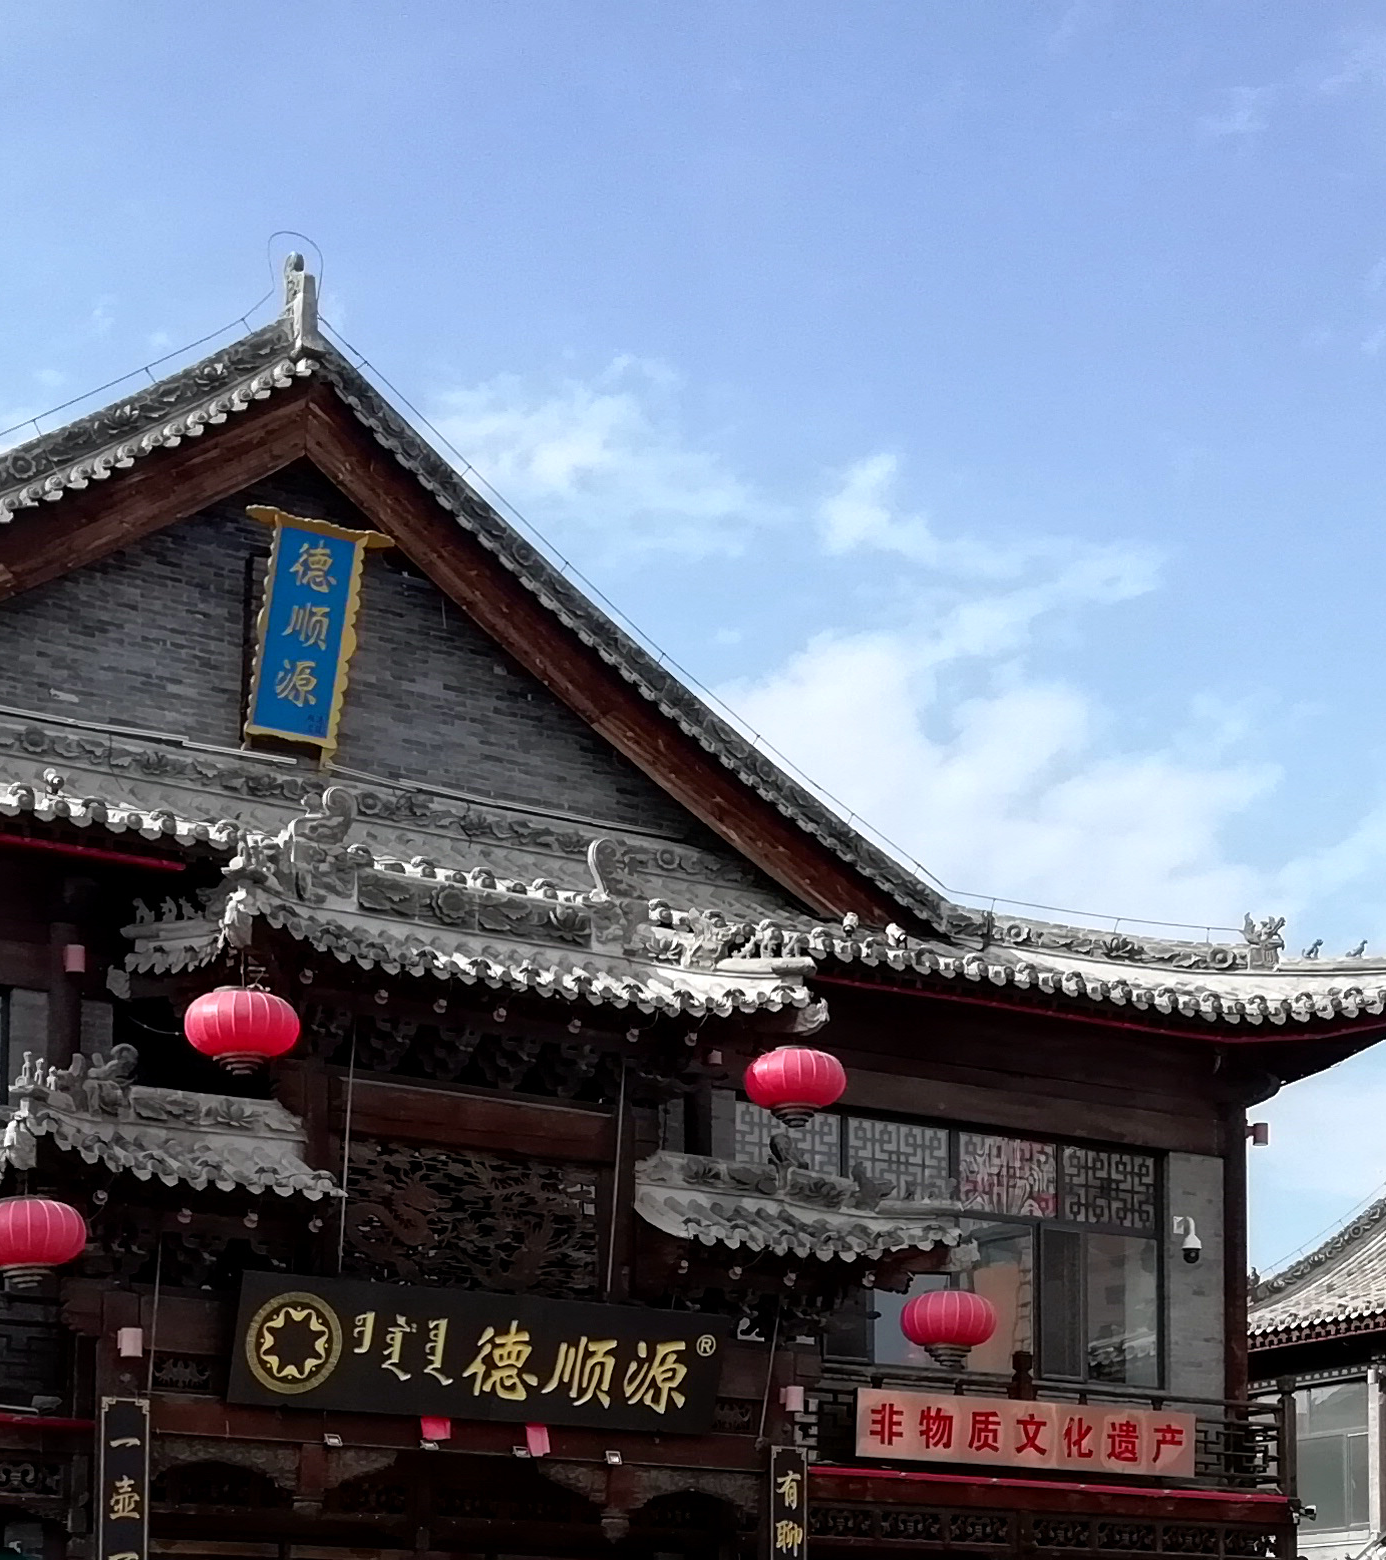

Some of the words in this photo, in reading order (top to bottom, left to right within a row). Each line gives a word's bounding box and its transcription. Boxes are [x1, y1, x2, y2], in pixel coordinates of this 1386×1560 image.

[275, 540, 337, 707] 德顺源
[462, 1320, 688, 1414] 德顺源
[869, 1402, 1184, 1464] 非物质文化遗产
